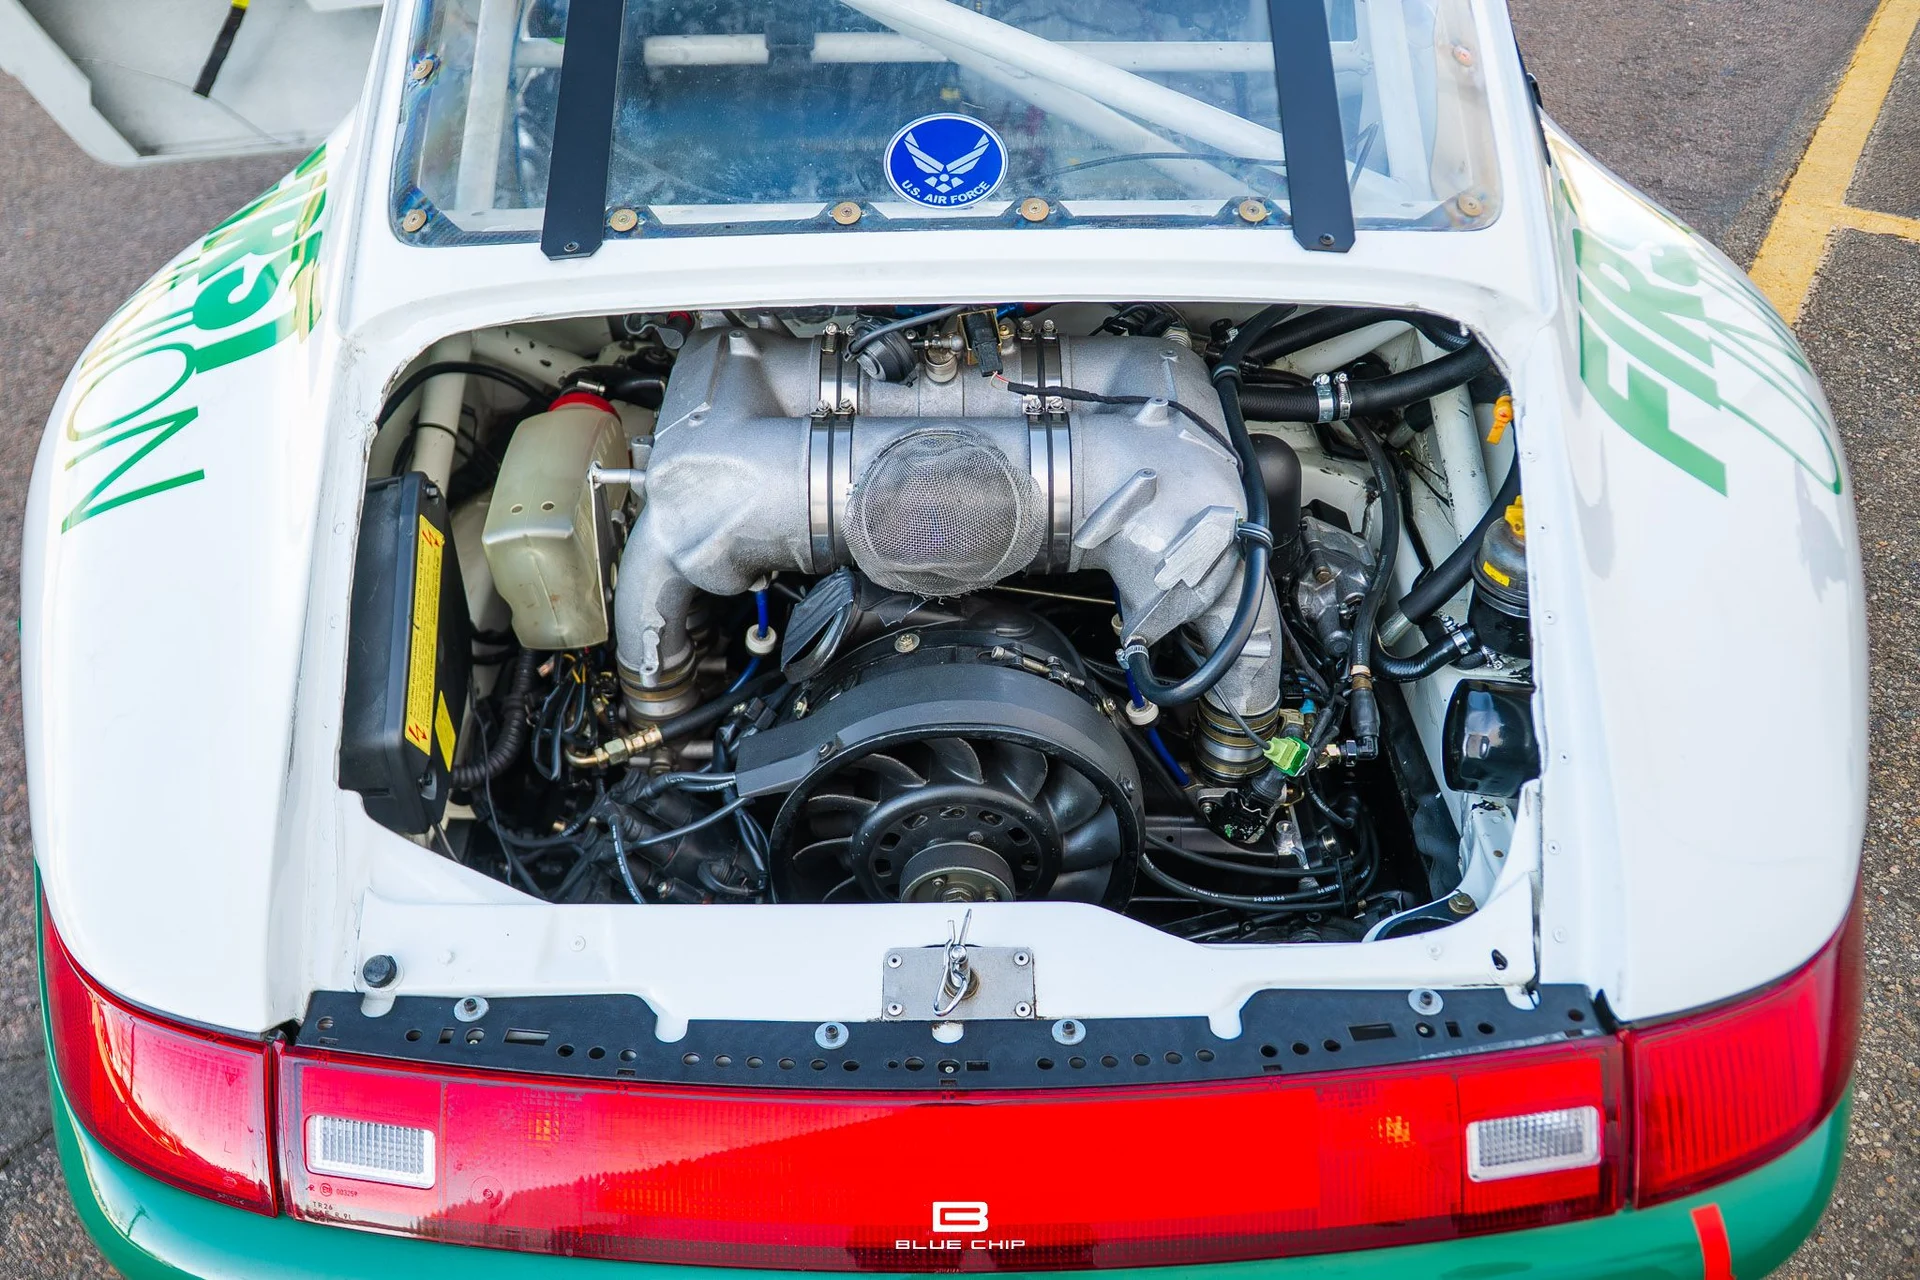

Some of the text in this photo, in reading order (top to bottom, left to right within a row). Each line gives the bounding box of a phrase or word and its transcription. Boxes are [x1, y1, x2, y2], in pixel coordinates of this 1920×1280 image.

[901, 180, 991, 204] U.S. AIR FORCE
